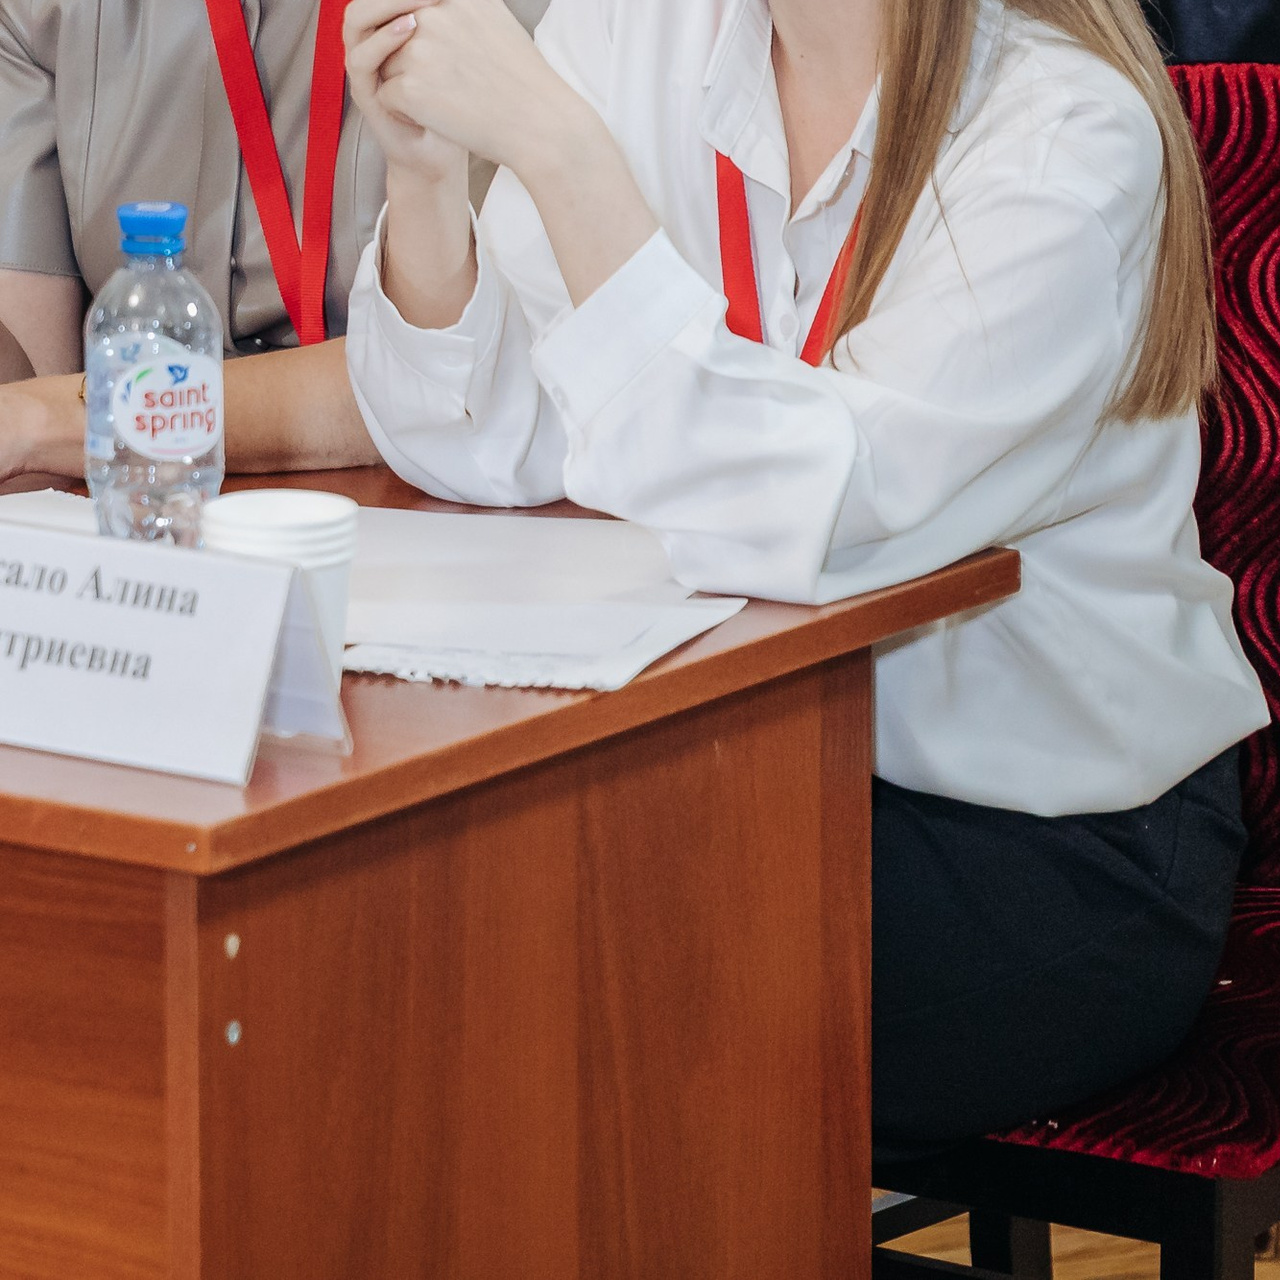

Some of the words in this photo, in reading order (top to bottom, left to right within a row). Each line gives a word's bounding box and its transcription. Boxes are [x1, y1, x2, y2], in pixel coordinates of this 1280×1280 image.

[144, 382, 209, 410] saint
[134, 407, 216, 440] spring
[76, 565, 200, 617] Алина
